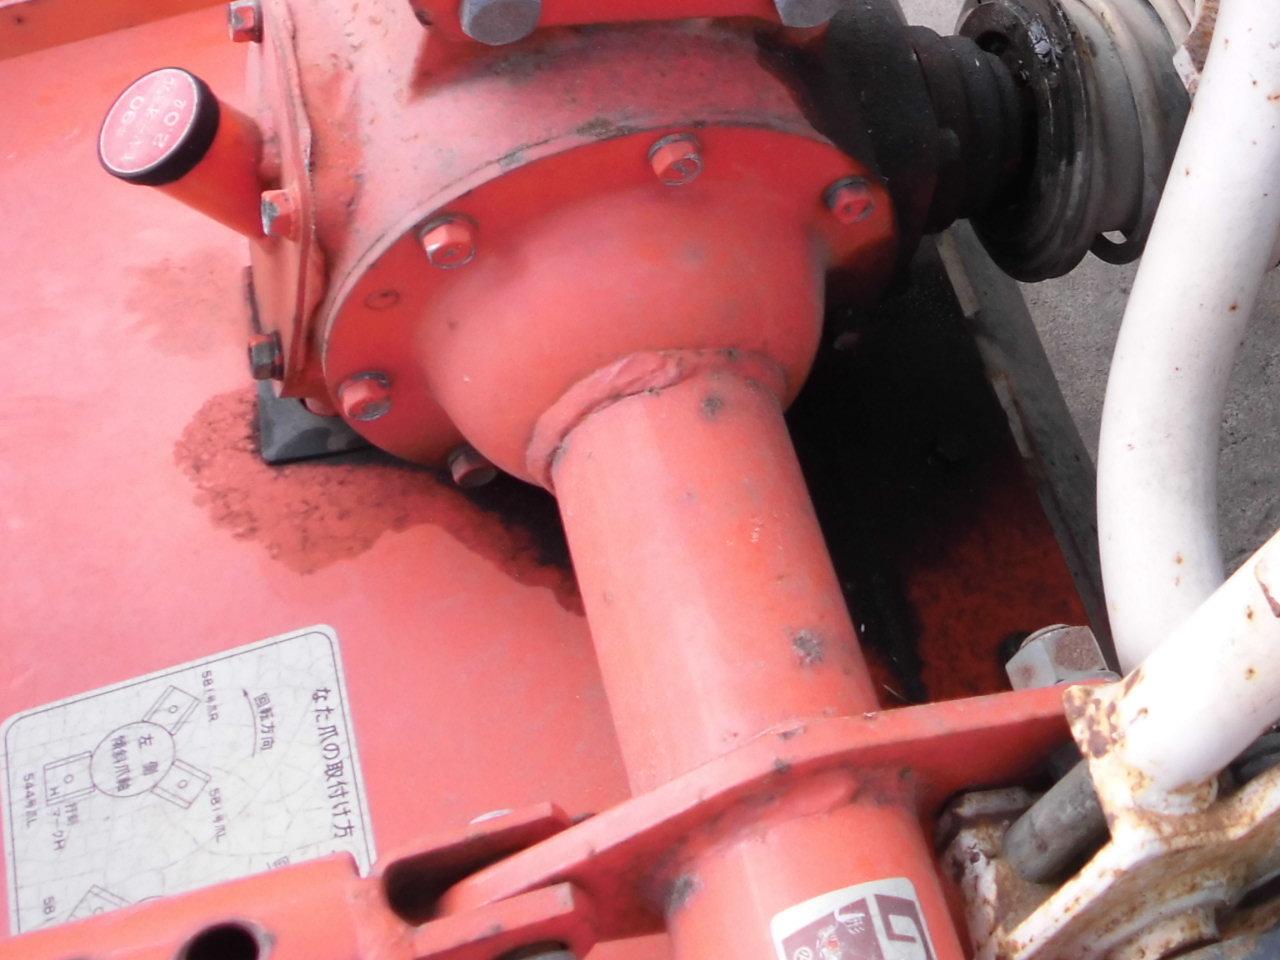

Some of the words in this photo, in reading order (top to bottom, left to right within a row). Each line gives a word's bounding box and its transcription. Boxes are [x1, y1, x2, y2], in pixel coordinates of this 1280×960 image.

[252, 692, 276, 752] 回転方向
[312, 687, 355, 839] なた爪の取付け方
